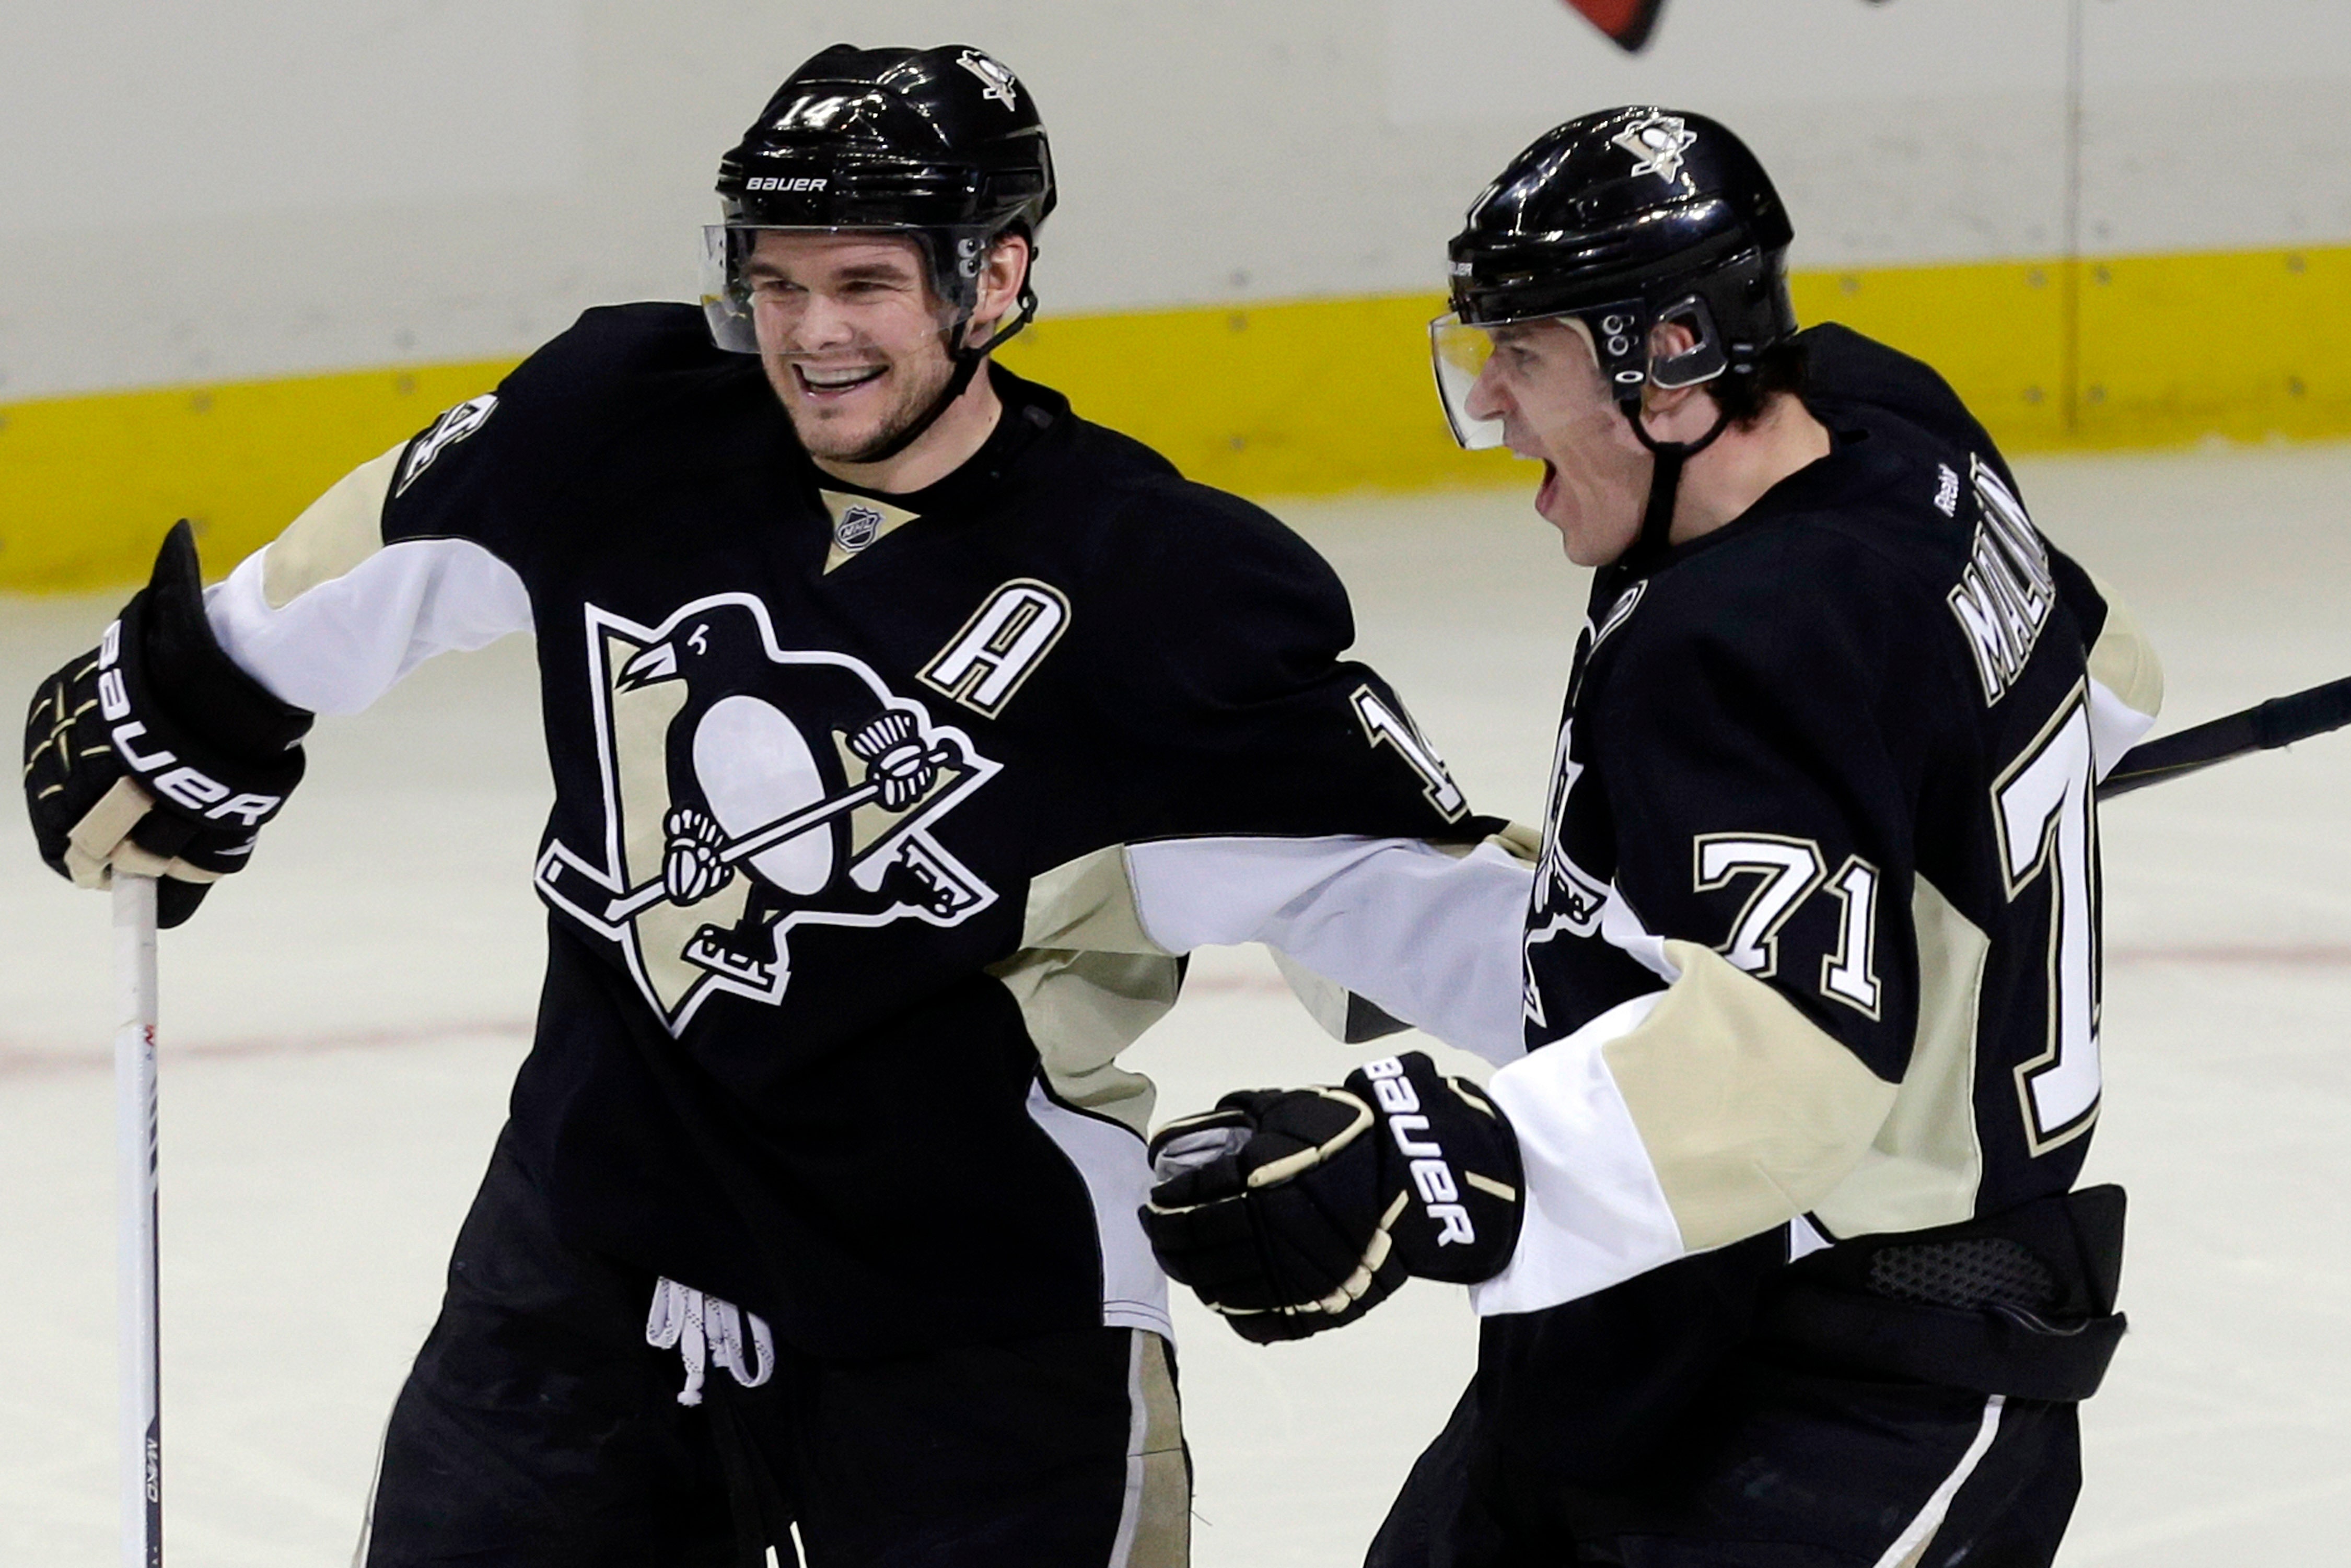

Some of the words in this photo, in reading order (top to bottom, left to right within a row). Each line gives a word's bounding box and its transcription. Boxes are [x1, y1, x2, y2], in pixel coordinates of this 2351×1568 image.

[746, 177, 828, 192] BAUER
[98, 619, 281, 826] BAUER
[915, 577, 1072, 720] A
[1348, 683, 1470, 824] 1
[1693, 832, 1881, 1022] 71
[1363, 1056, 1475, 1247] BAUER
